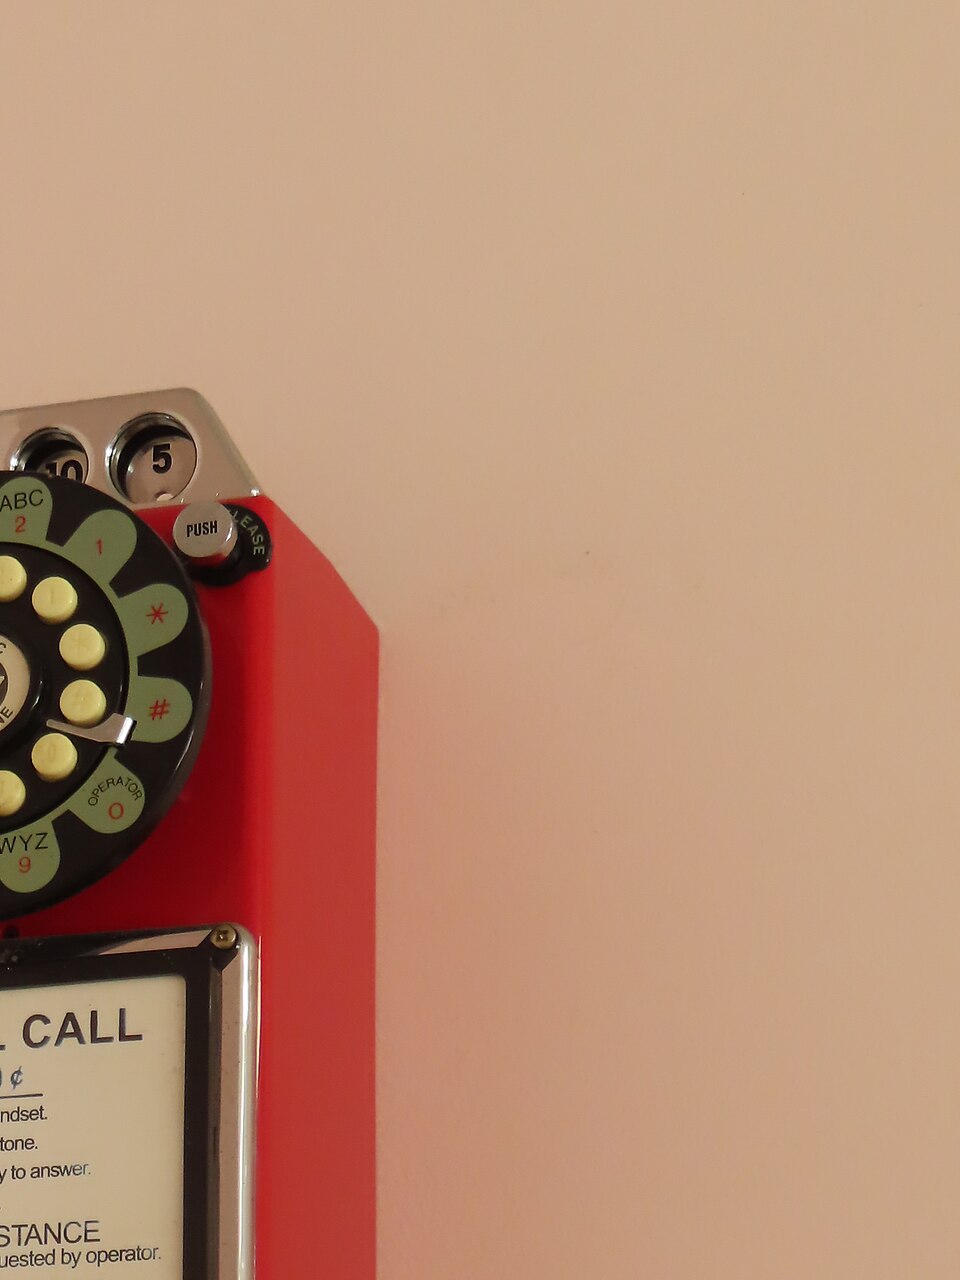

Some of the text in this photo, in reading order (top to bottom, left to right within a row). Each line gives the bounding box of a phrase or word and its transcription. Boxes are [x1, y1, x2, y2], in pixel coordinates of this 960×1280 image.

[151, 443, 172, 474] 5
[0, 489, 44, 512] ABC
[14, 515, 27, 534] 2
[185, 520, 219, 538] PUSH
[95, 538, 104, 556] 1
[87, 776, 143, 807] OPERATOR
[17, 856, 32, 874] 9
[22, 1007, 144, 1050] CALL
[10, 1165, 27, 1180] to
[30, 1161, 92, 1180] answer.
[60, 1247, 81, 1269] by
[85, 1245, 162, 1268] operator.
